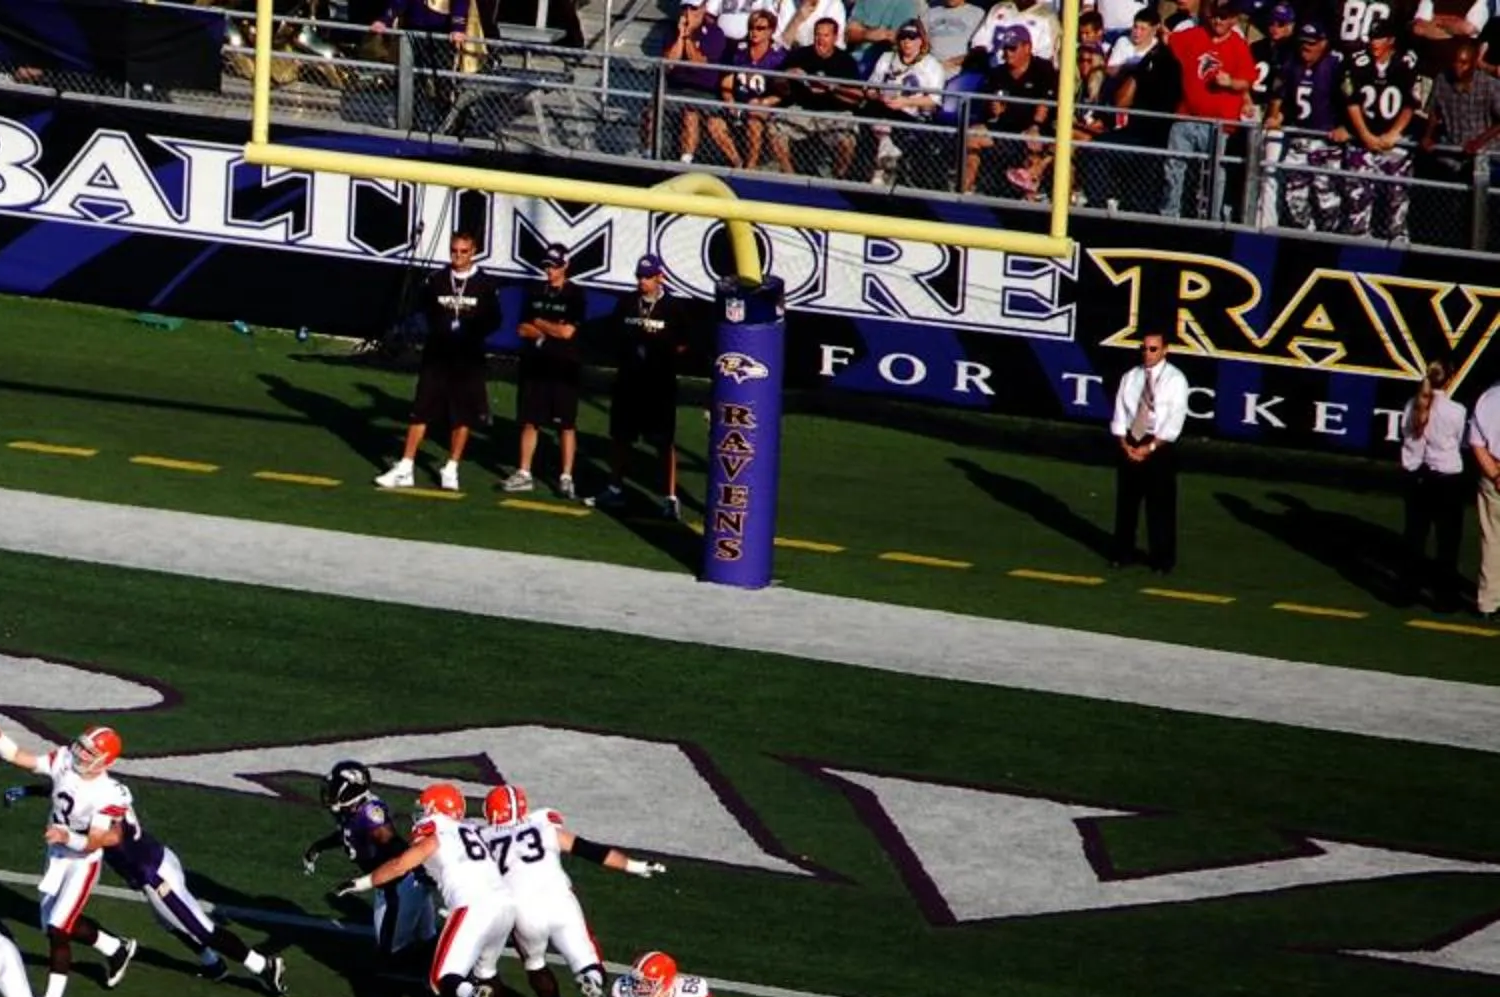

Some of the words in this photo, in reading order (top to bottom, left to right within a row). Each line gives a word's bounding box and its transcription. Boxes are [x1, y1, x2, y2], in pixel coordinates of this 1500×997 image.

[1360, 84, 1403, 119] 20
[819, 344, 995, 395] FOR
[1061, 372, 1406, 442] TCKET
[714, 403, 756, 561] RAVENS
[490, 827, 546, 876] 73
